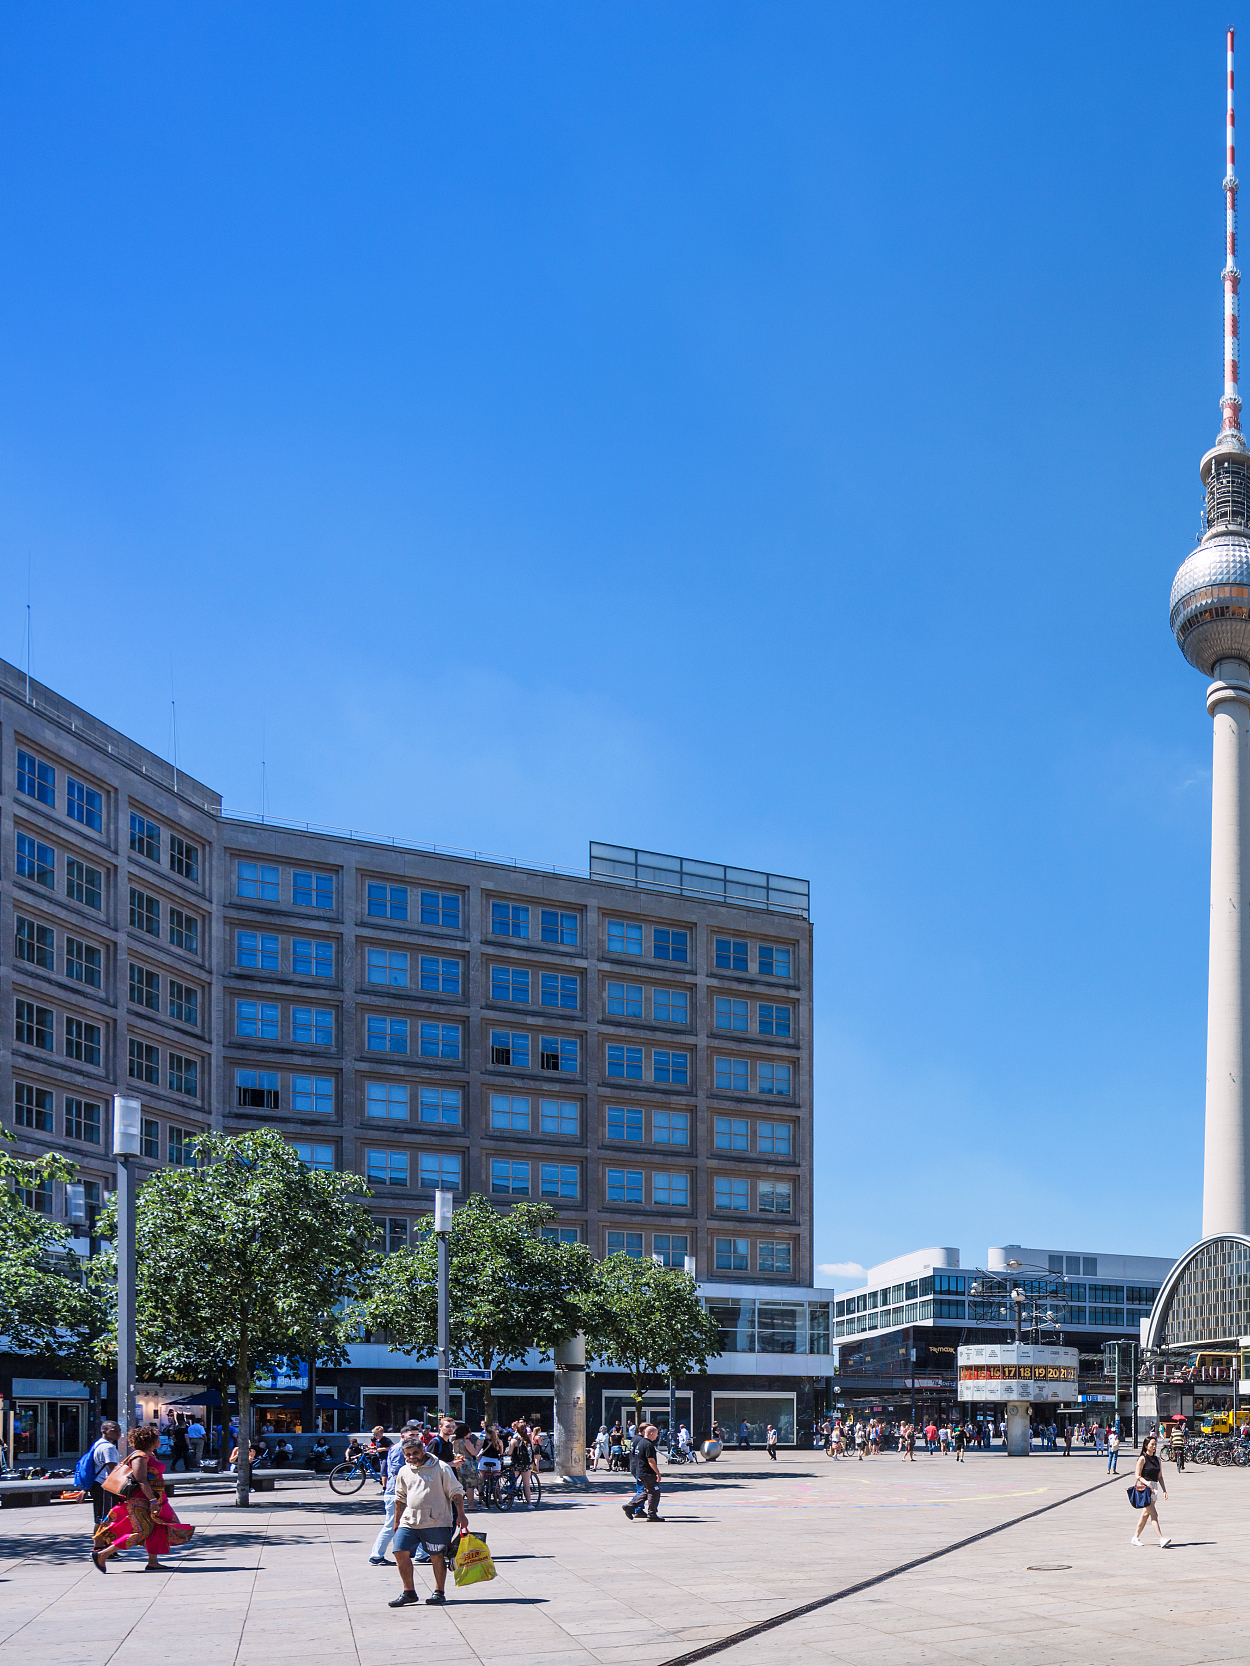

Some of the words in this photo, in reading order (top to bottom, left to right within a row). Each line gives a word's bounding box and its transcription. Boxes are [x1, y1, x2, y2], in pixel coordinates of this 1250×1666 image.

[990, 1367, 1000, 1377] 16
[1003, 1367, 1016, 1377] 17
[1020, 1367, 1031, 1377] 18
[1034, 1368, 1046, 1377] 19
[1048, 1368, 1059, 1378] 20
[1060, 1368, 1067, 1378] 21
